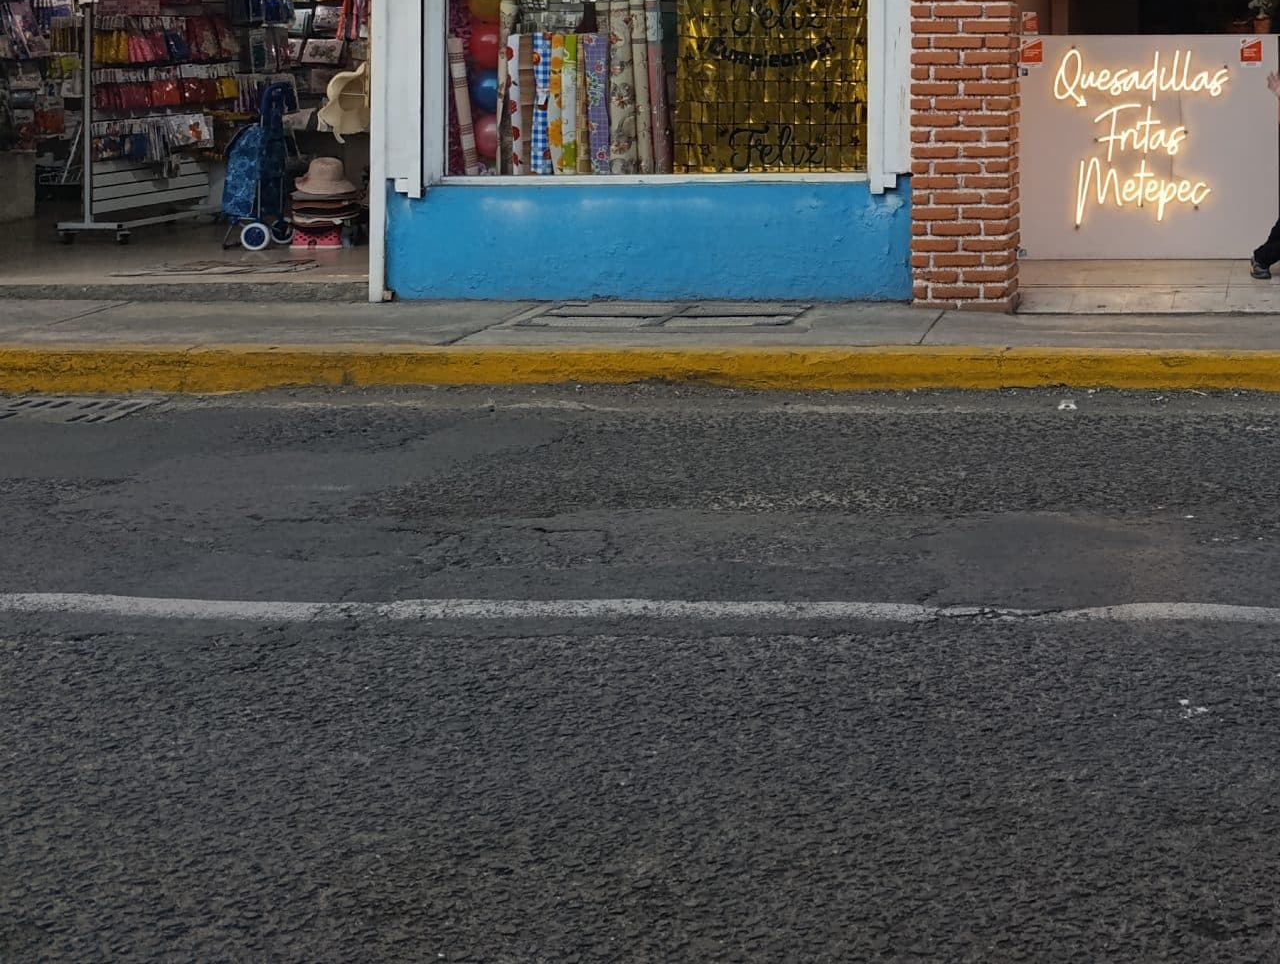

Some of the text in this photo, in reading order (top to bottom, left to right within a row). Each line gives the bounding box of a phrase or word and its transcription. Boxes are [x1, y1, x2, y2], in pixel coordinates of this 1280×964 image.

[1053, 48, 1229, 107] Quesadillas
[729, 123, 824, 171] Feliz
[1094, 103, 1188, 161] Fritas
[1076, 156, 1210, 226] Metepec
